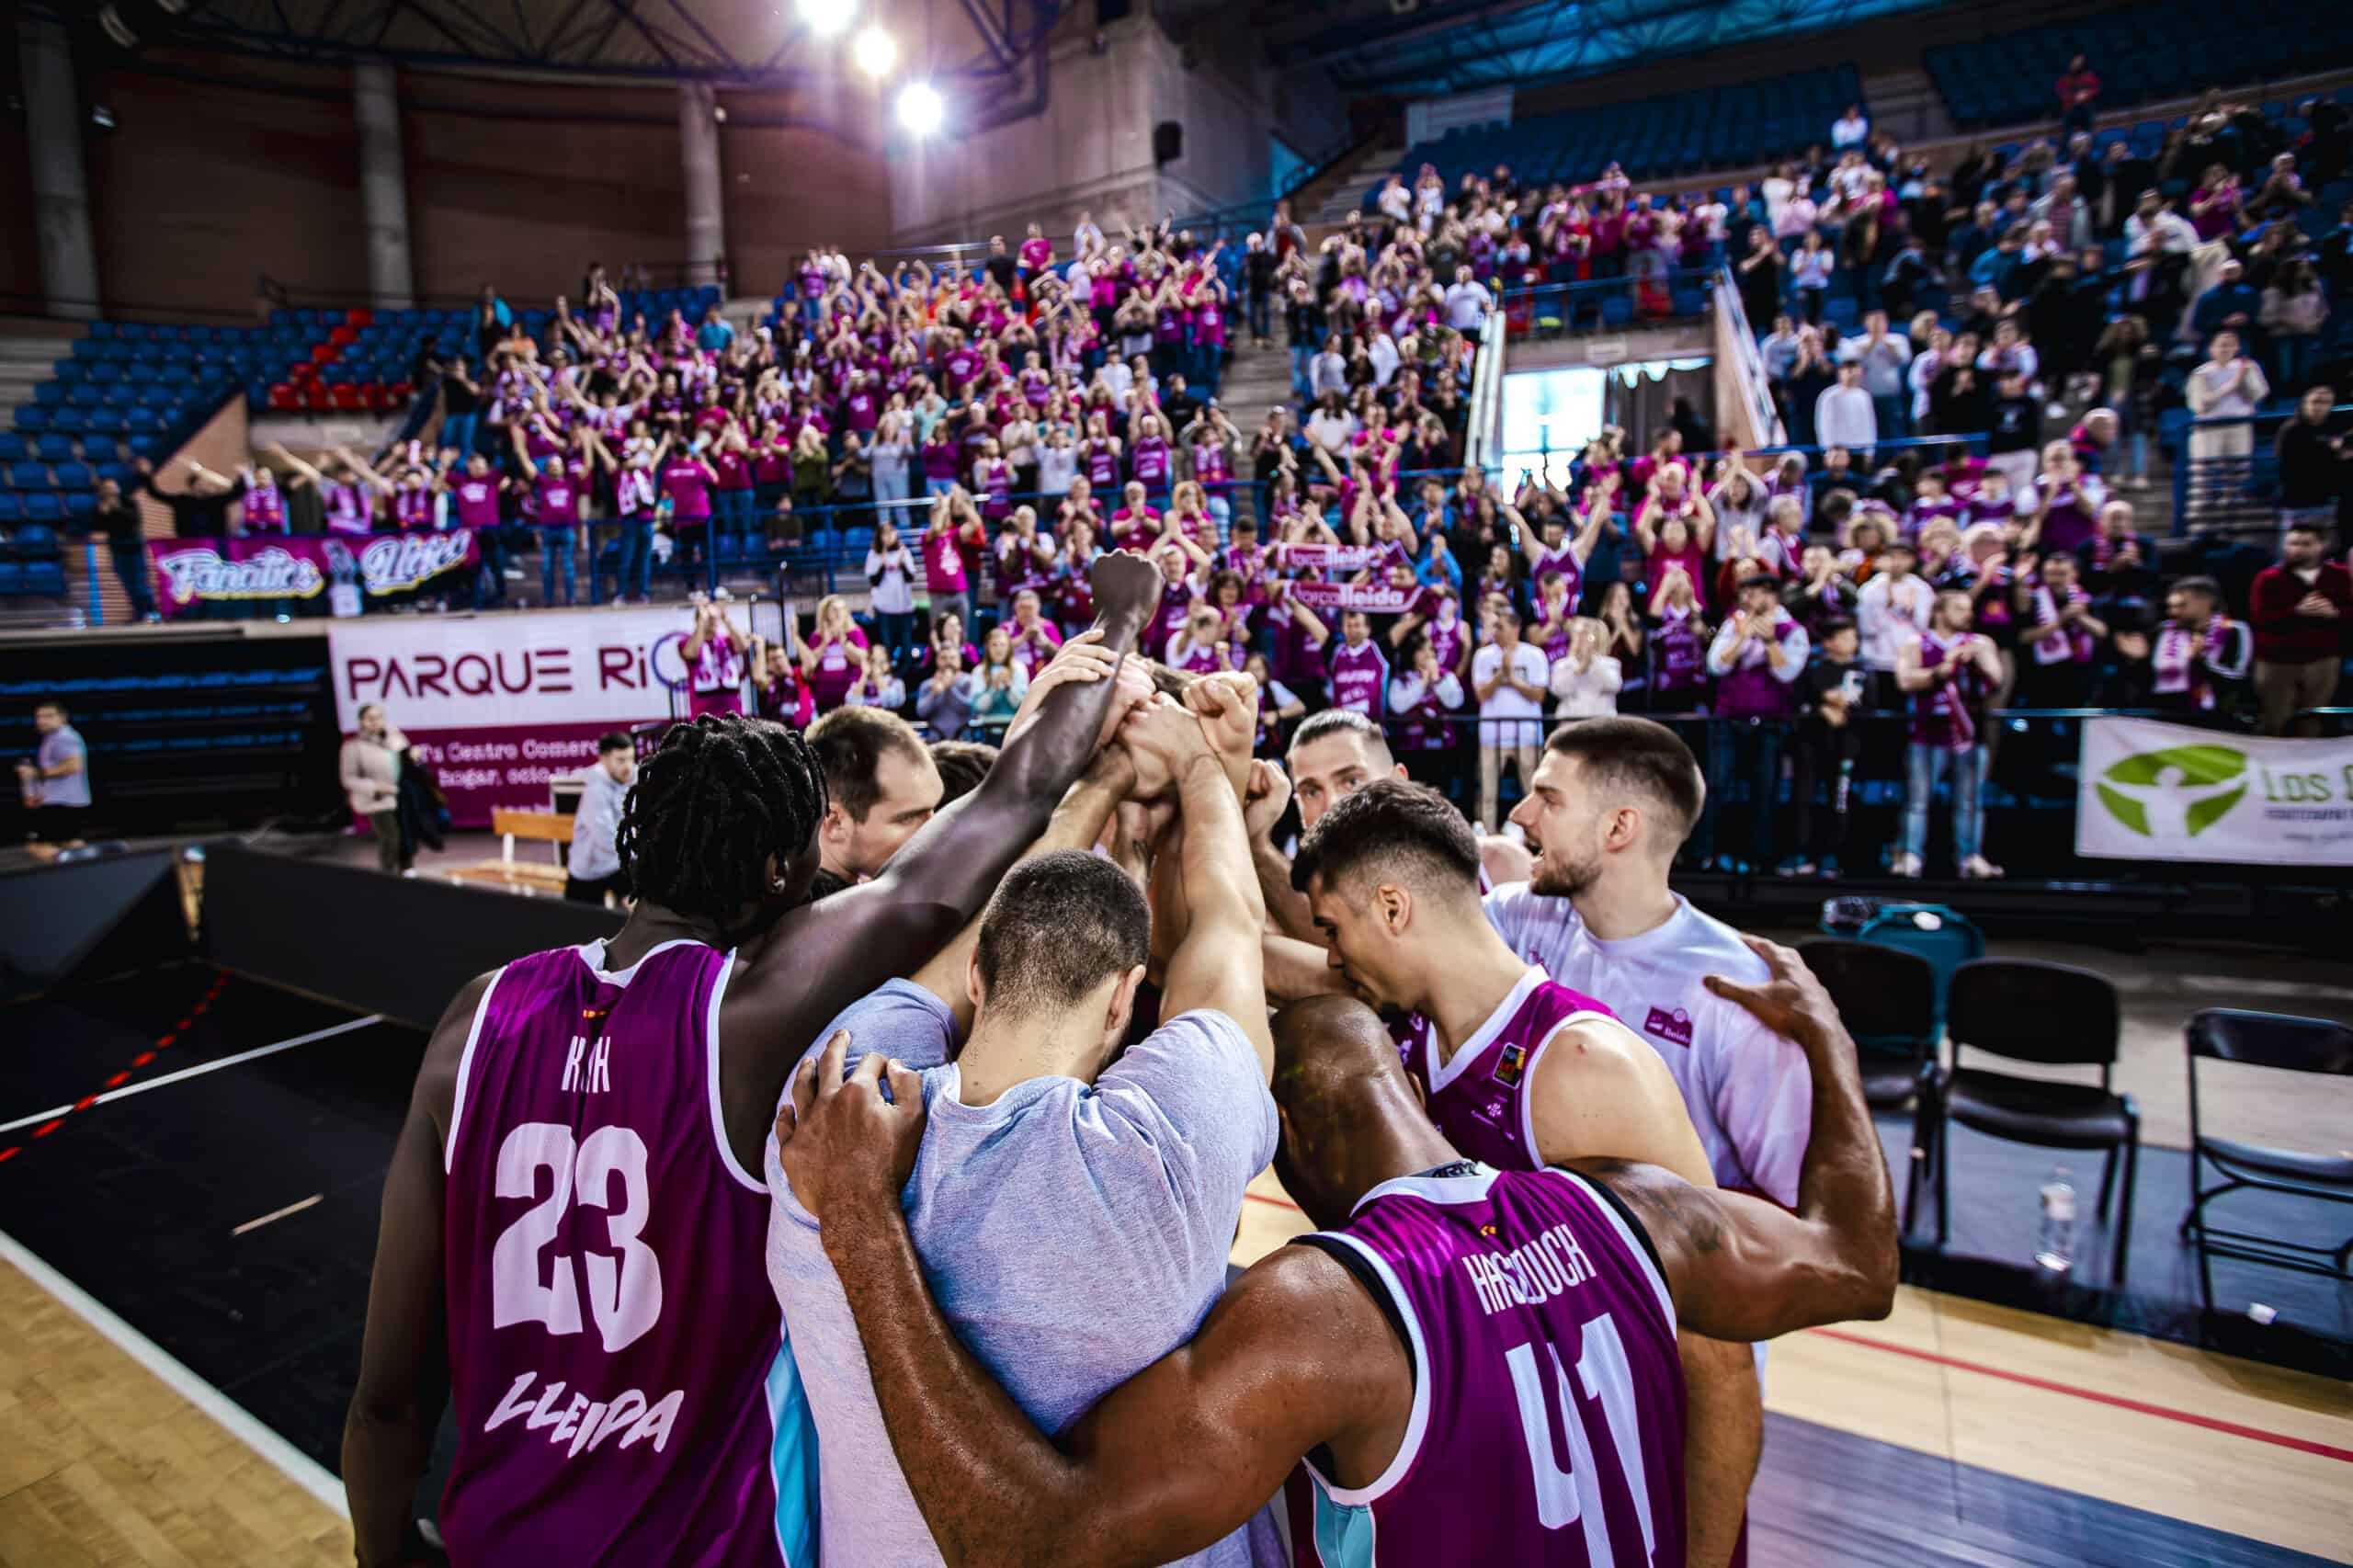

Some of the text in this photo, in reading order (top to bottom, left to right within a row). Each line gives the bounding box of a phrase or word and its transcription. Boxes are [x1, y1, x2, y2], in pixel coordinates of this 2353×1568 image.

[347, 650, 574, 701] PARQUE
[493, 1121, 663, 1354] 23
[1505, 1312, 1656, 1568] 41
